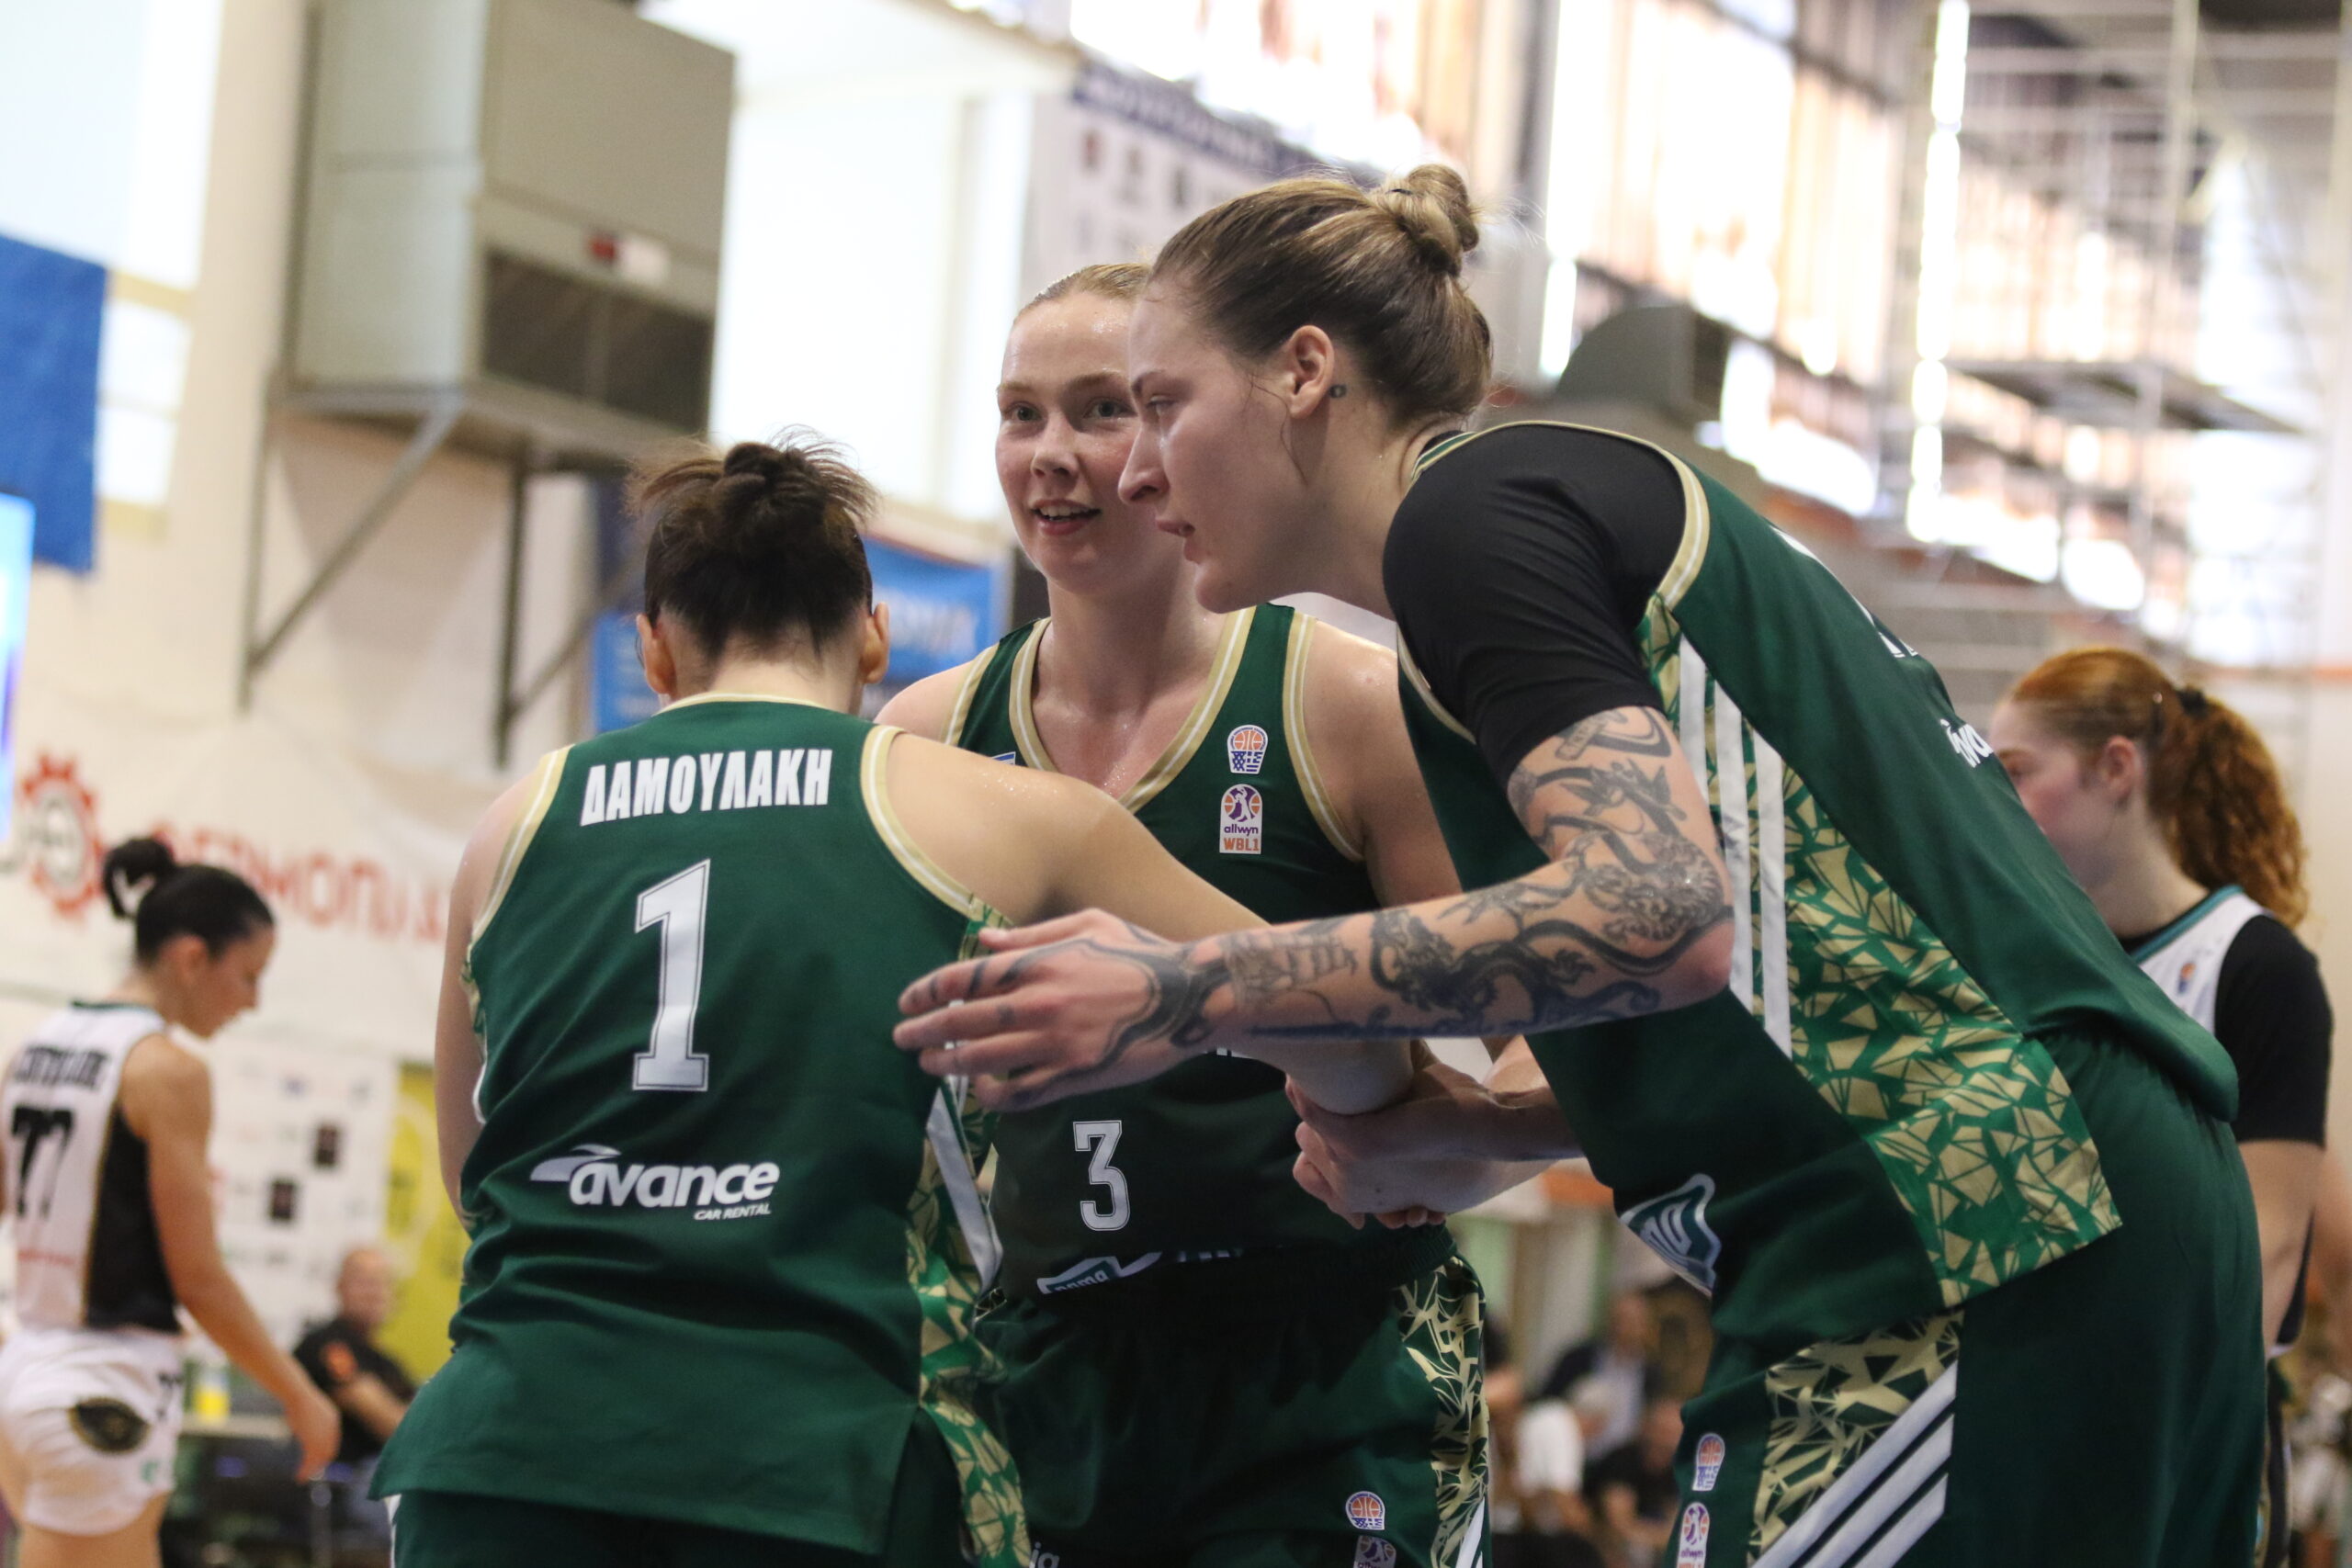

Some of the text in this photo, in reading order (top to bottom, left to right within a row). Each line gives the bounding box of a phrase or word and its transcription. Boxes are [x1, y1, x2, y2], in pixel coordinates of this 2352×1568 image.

[580, 749, 832, 827] ΔΑΜΟΥΛΑΚΗ
[1223, 838, 1260, 852] WBL1
[1224, 823, 1259, 836] allwyn
[632, 858, 711, 1092] 1
[11, 1105, 74, 1220] 77
[569, 1161, 781, 1208] avance
[1072, 1120, 1131, 1232] 3
[694, 1202, 771, 1220] CAR RENTAL
